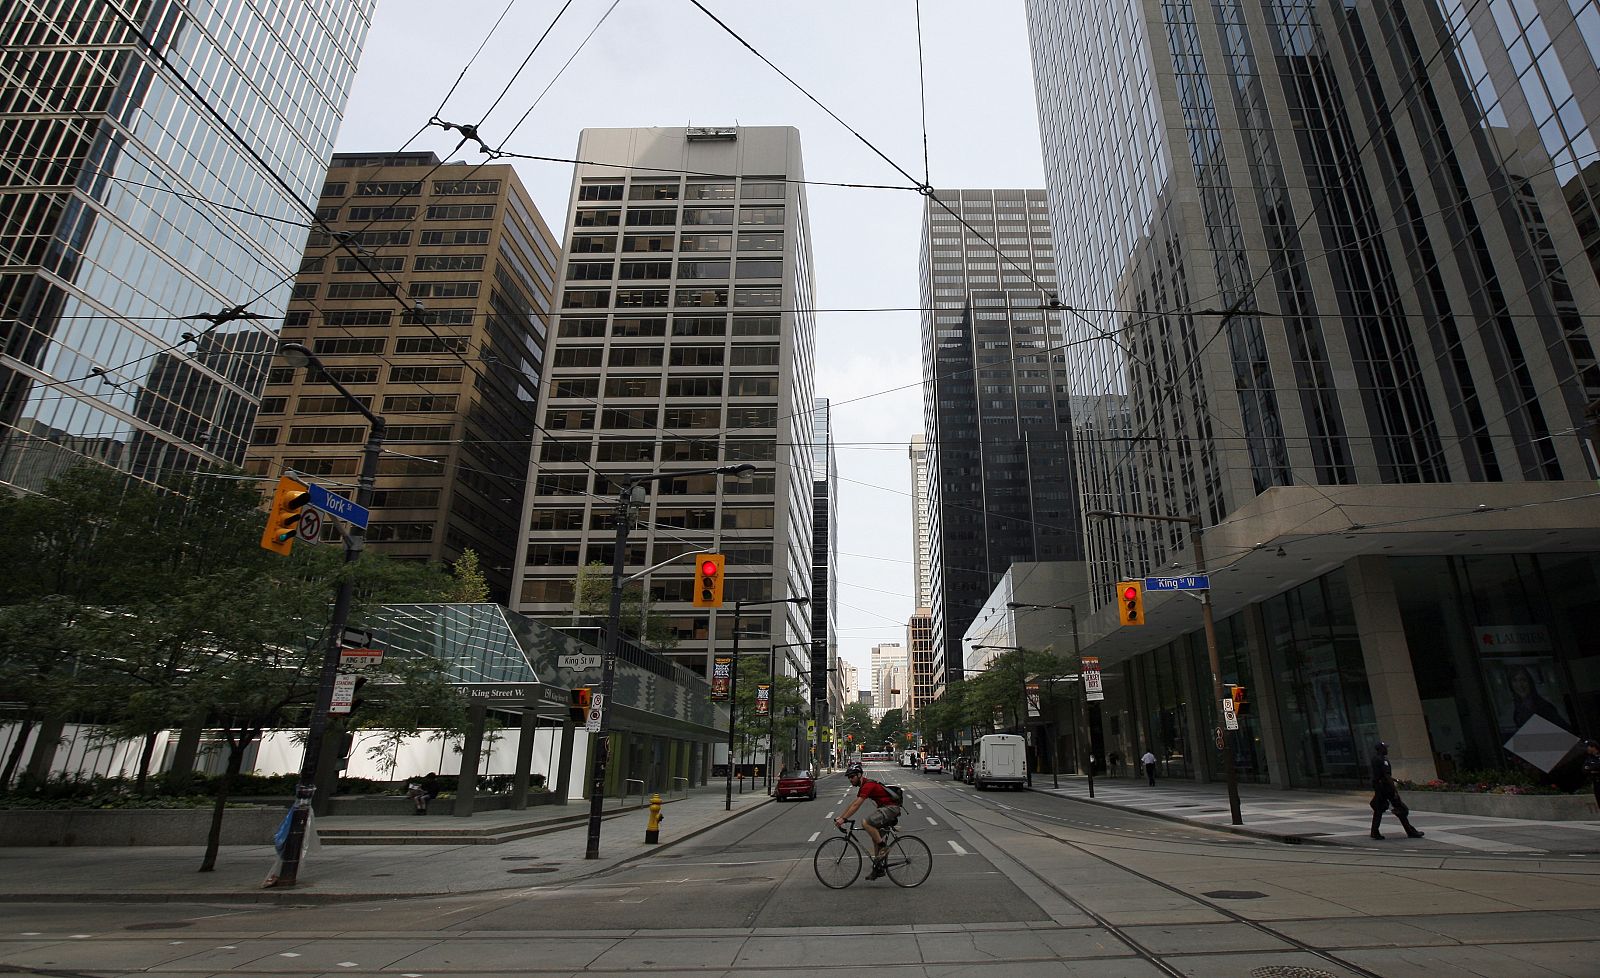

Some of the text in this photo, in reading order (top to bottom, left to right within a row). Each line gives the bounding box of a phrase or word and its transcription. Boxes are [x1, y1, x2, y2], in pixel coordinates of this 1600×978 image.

[325, 493, 353, 513] York St
[1158, 577, 1178, 588] King
[1187, 577, 1195, 587] W
[345, 656, 358, 664] KING
[564, 657, 579, 666] King
[471, 689, 490, 699] King
[491, 689, 513, 697] Street
[515, 688, 526, 697] W.
